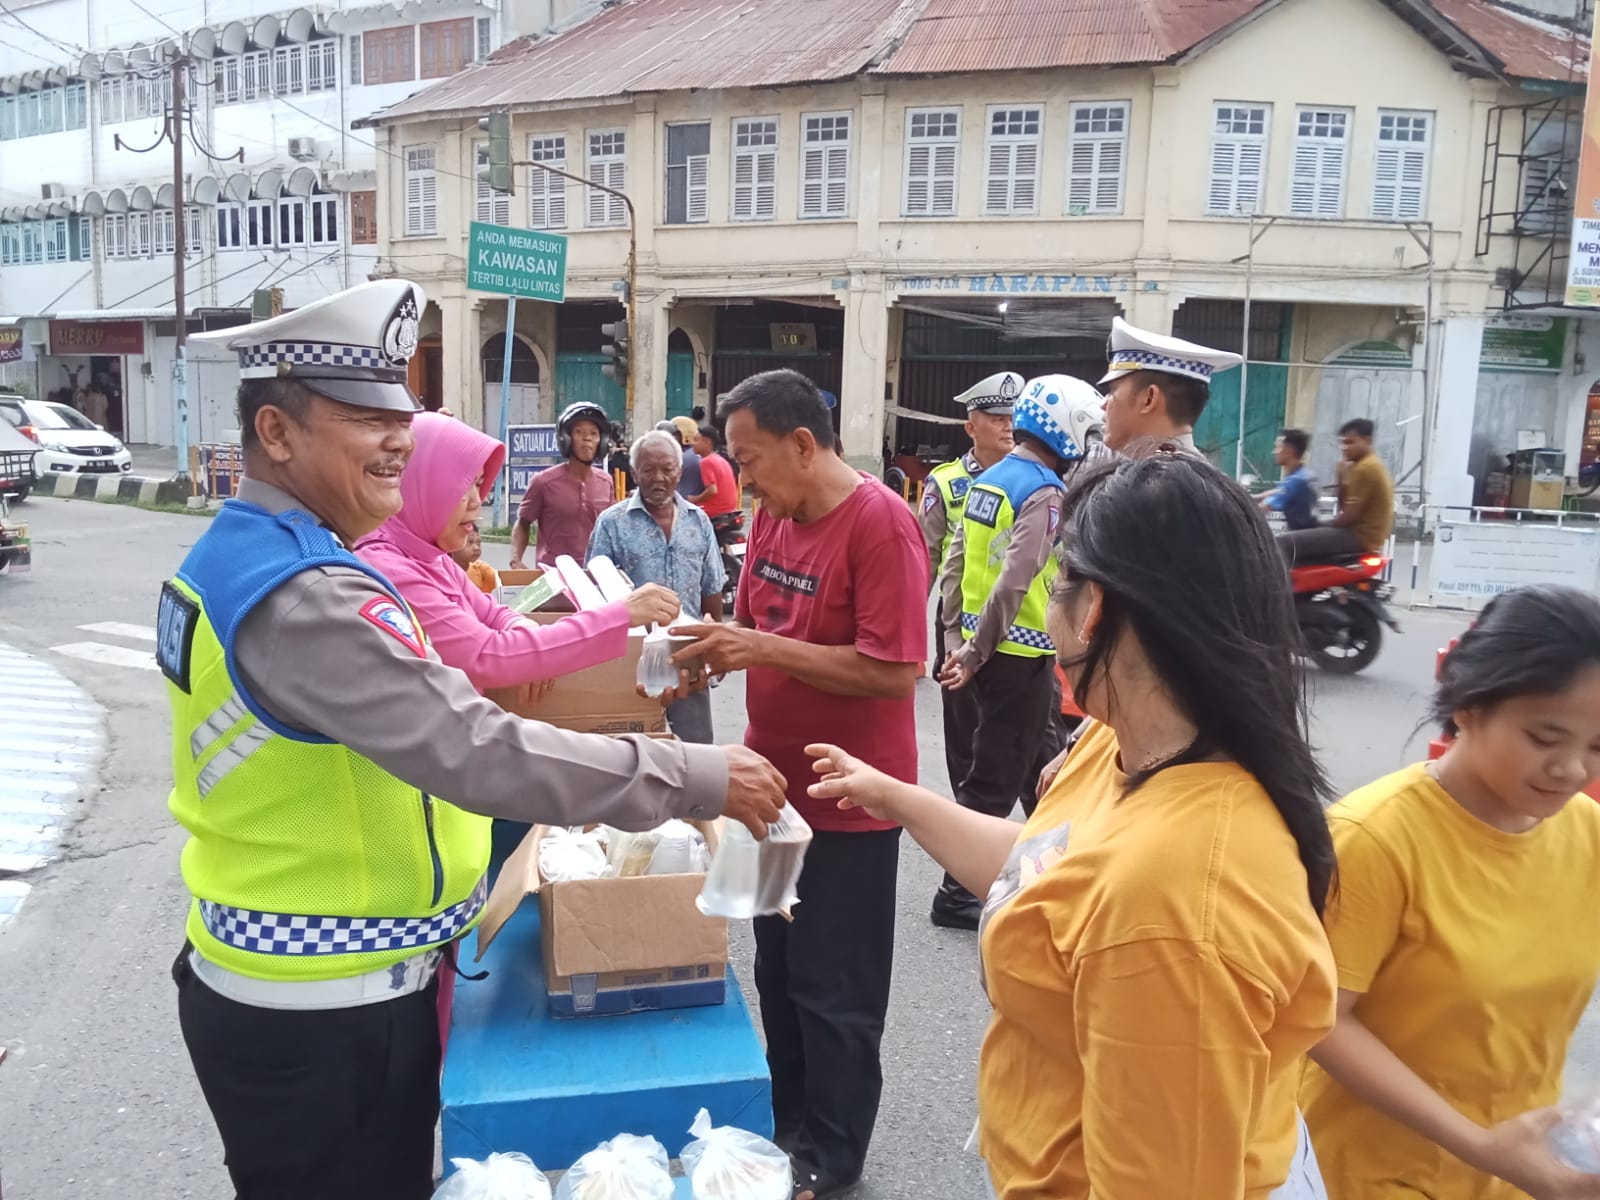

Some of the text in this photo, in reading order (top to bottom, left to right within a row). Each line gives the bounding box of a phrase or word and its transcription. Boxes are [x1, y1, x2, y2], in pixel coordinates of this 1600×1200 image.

[476, 231, 562, 254] ANDA MEMASUKI
[478, 249, 558, 276] KAWASAN
[472, 271, 560, 294] TERTIB LALU LINTAS
[968, 276, 1113, 292] HARAPAN
[513, 433, 560, 452] SATUAN LA
[513, 470, 533, 490] POLR
